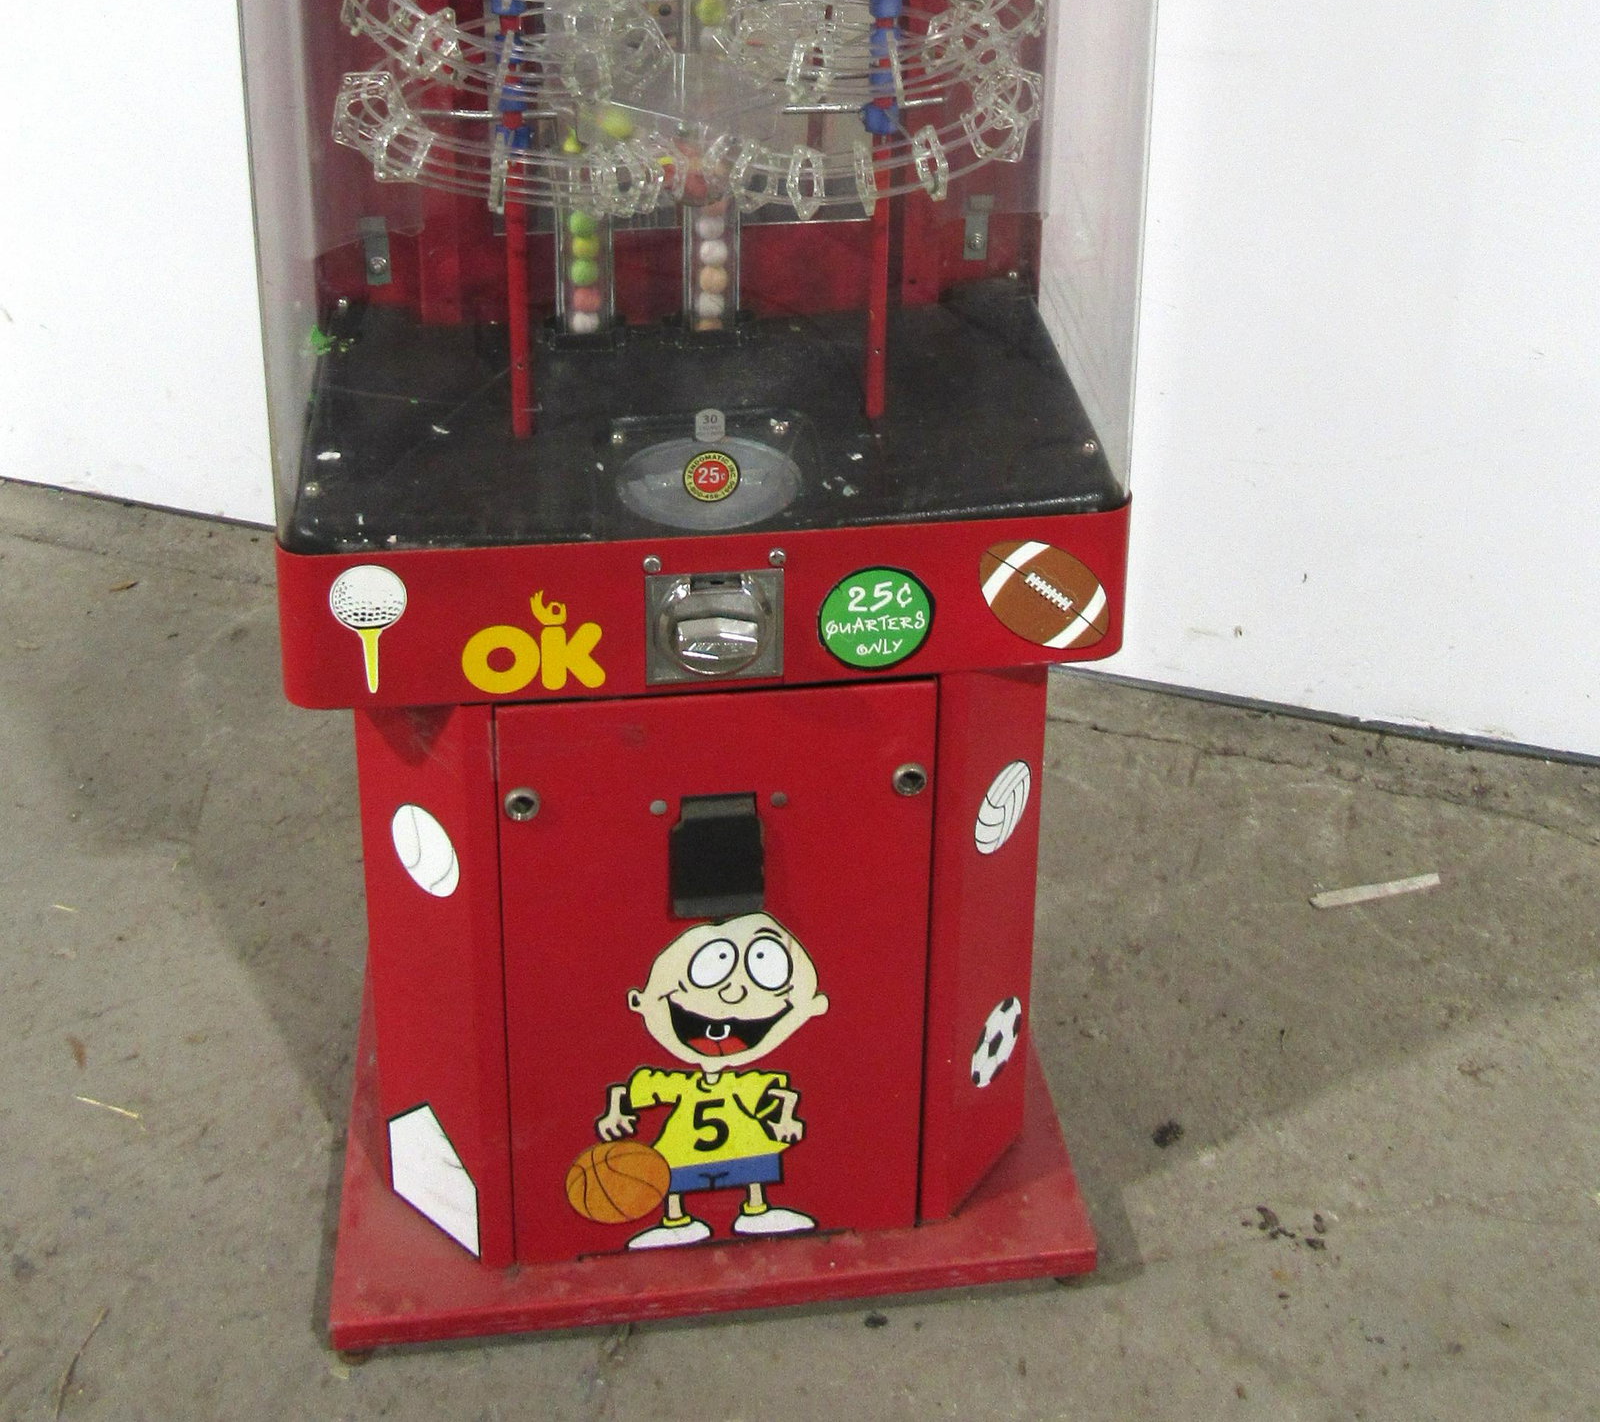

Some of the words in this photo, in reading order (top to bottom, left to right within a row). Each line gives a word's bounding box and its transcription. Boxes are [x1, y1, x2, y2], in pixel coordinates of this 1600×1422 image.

[702, 414, 718, 424] 30
[848, 581, 912, 612] 25¢
[826, 611, 925, 639] QUARTERS
[856, 639, 902, 655] ONLY
[694, 1099, 729, 1151] 5
